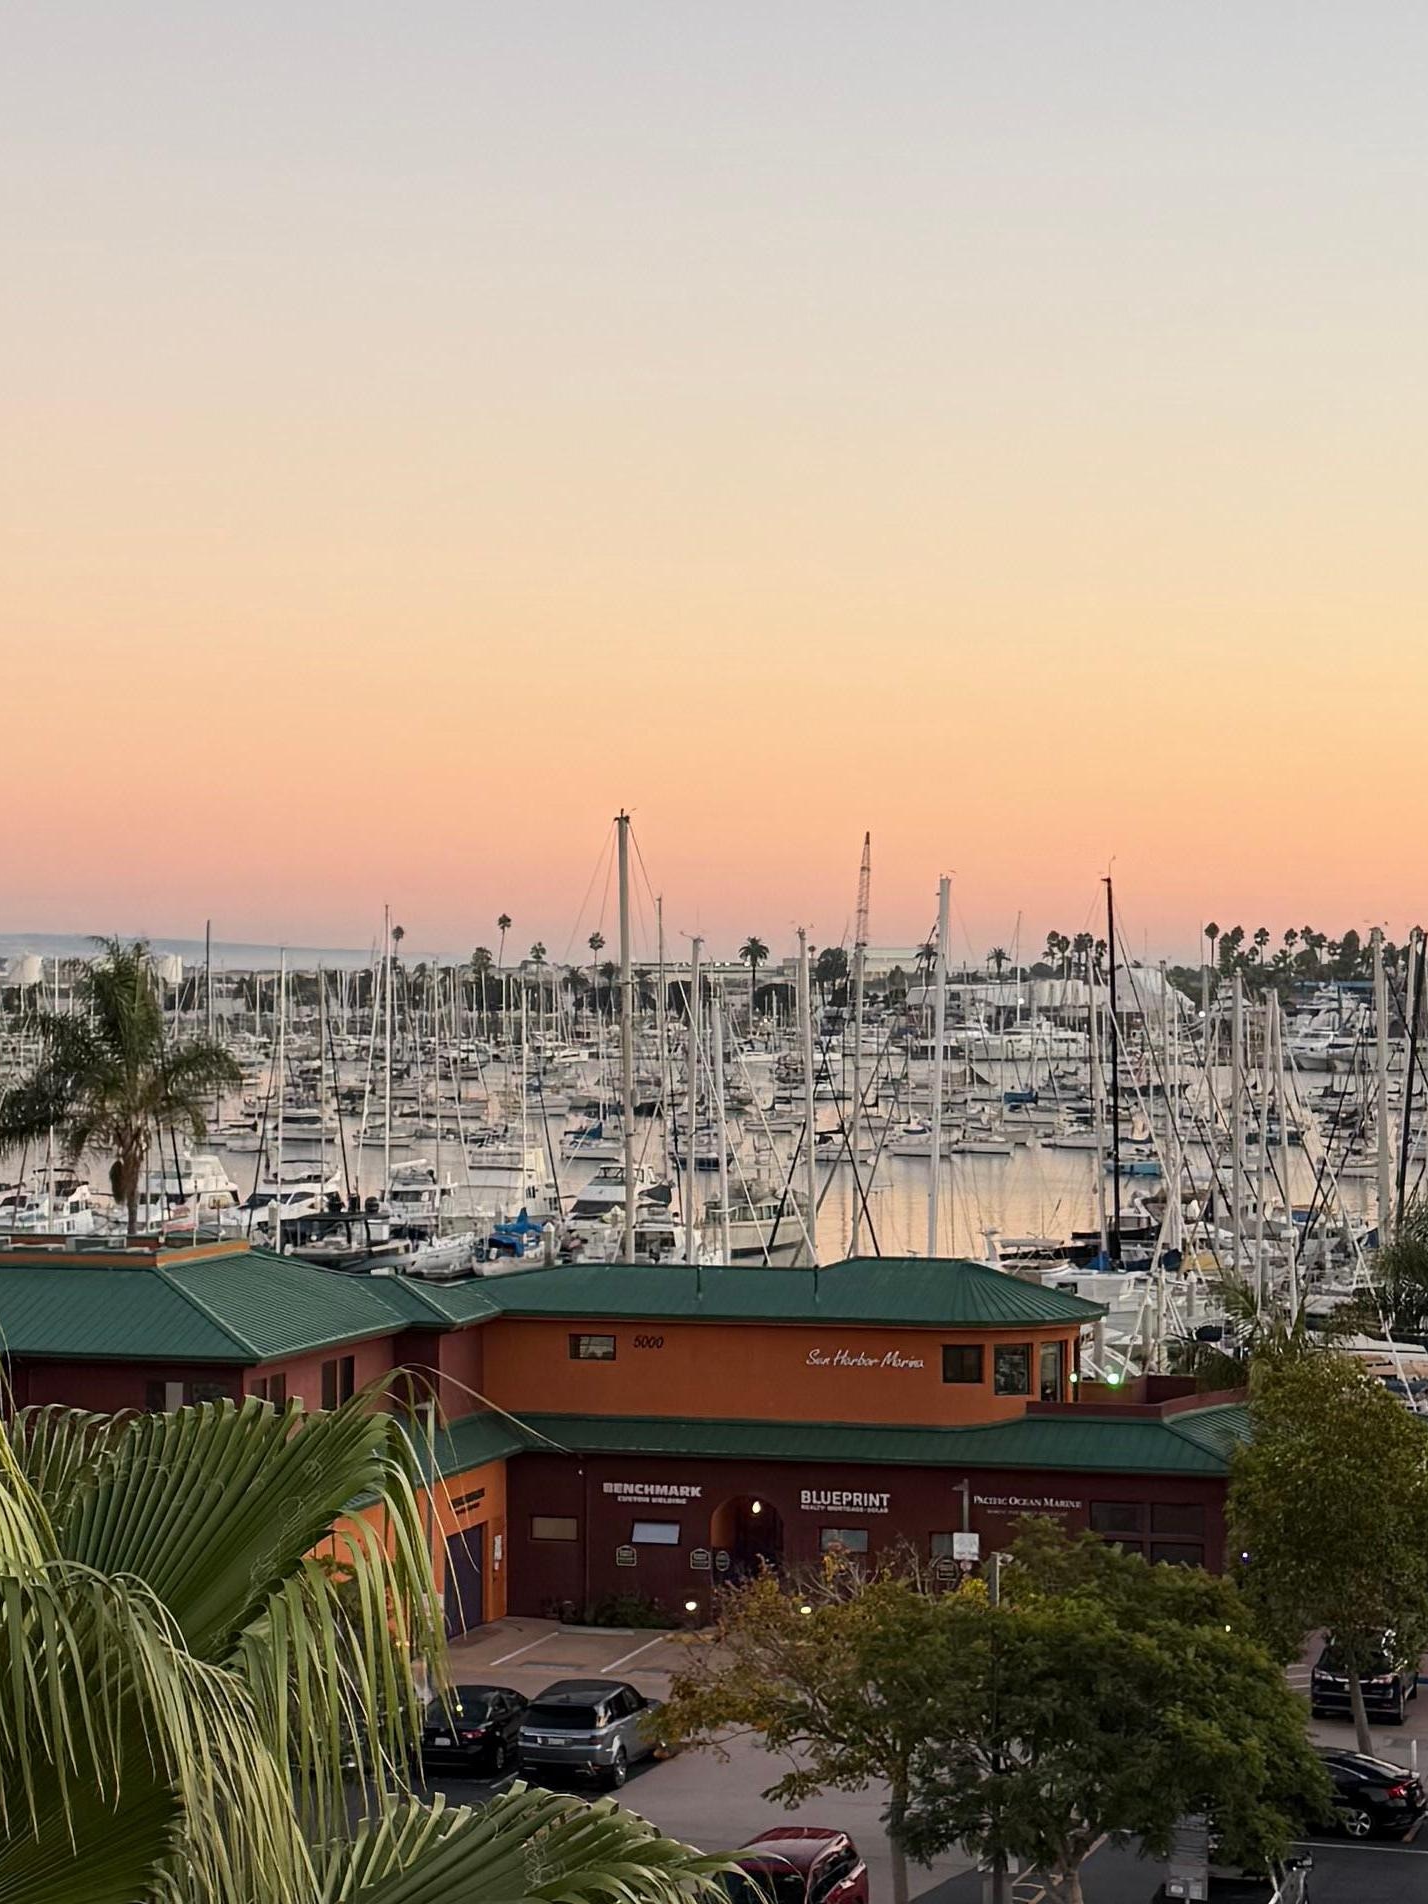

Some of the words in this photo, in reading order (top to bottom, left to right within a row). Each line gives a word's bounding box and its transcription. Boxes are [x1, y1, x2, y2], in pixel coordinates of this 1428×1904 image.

[633, 1335, 664, 1349] 5000
[806, 1349, 830, 1365] Sun
[833, 1349, 879, 1367] Harbor
[880, 1351, 924, 1368] Marina
[602, 1482, 702, 1497] BENCHMARK
[800, 1490, 890, 1507] BLUEPRINT
[1009, 1496, 1042, 1507] OCEAN
